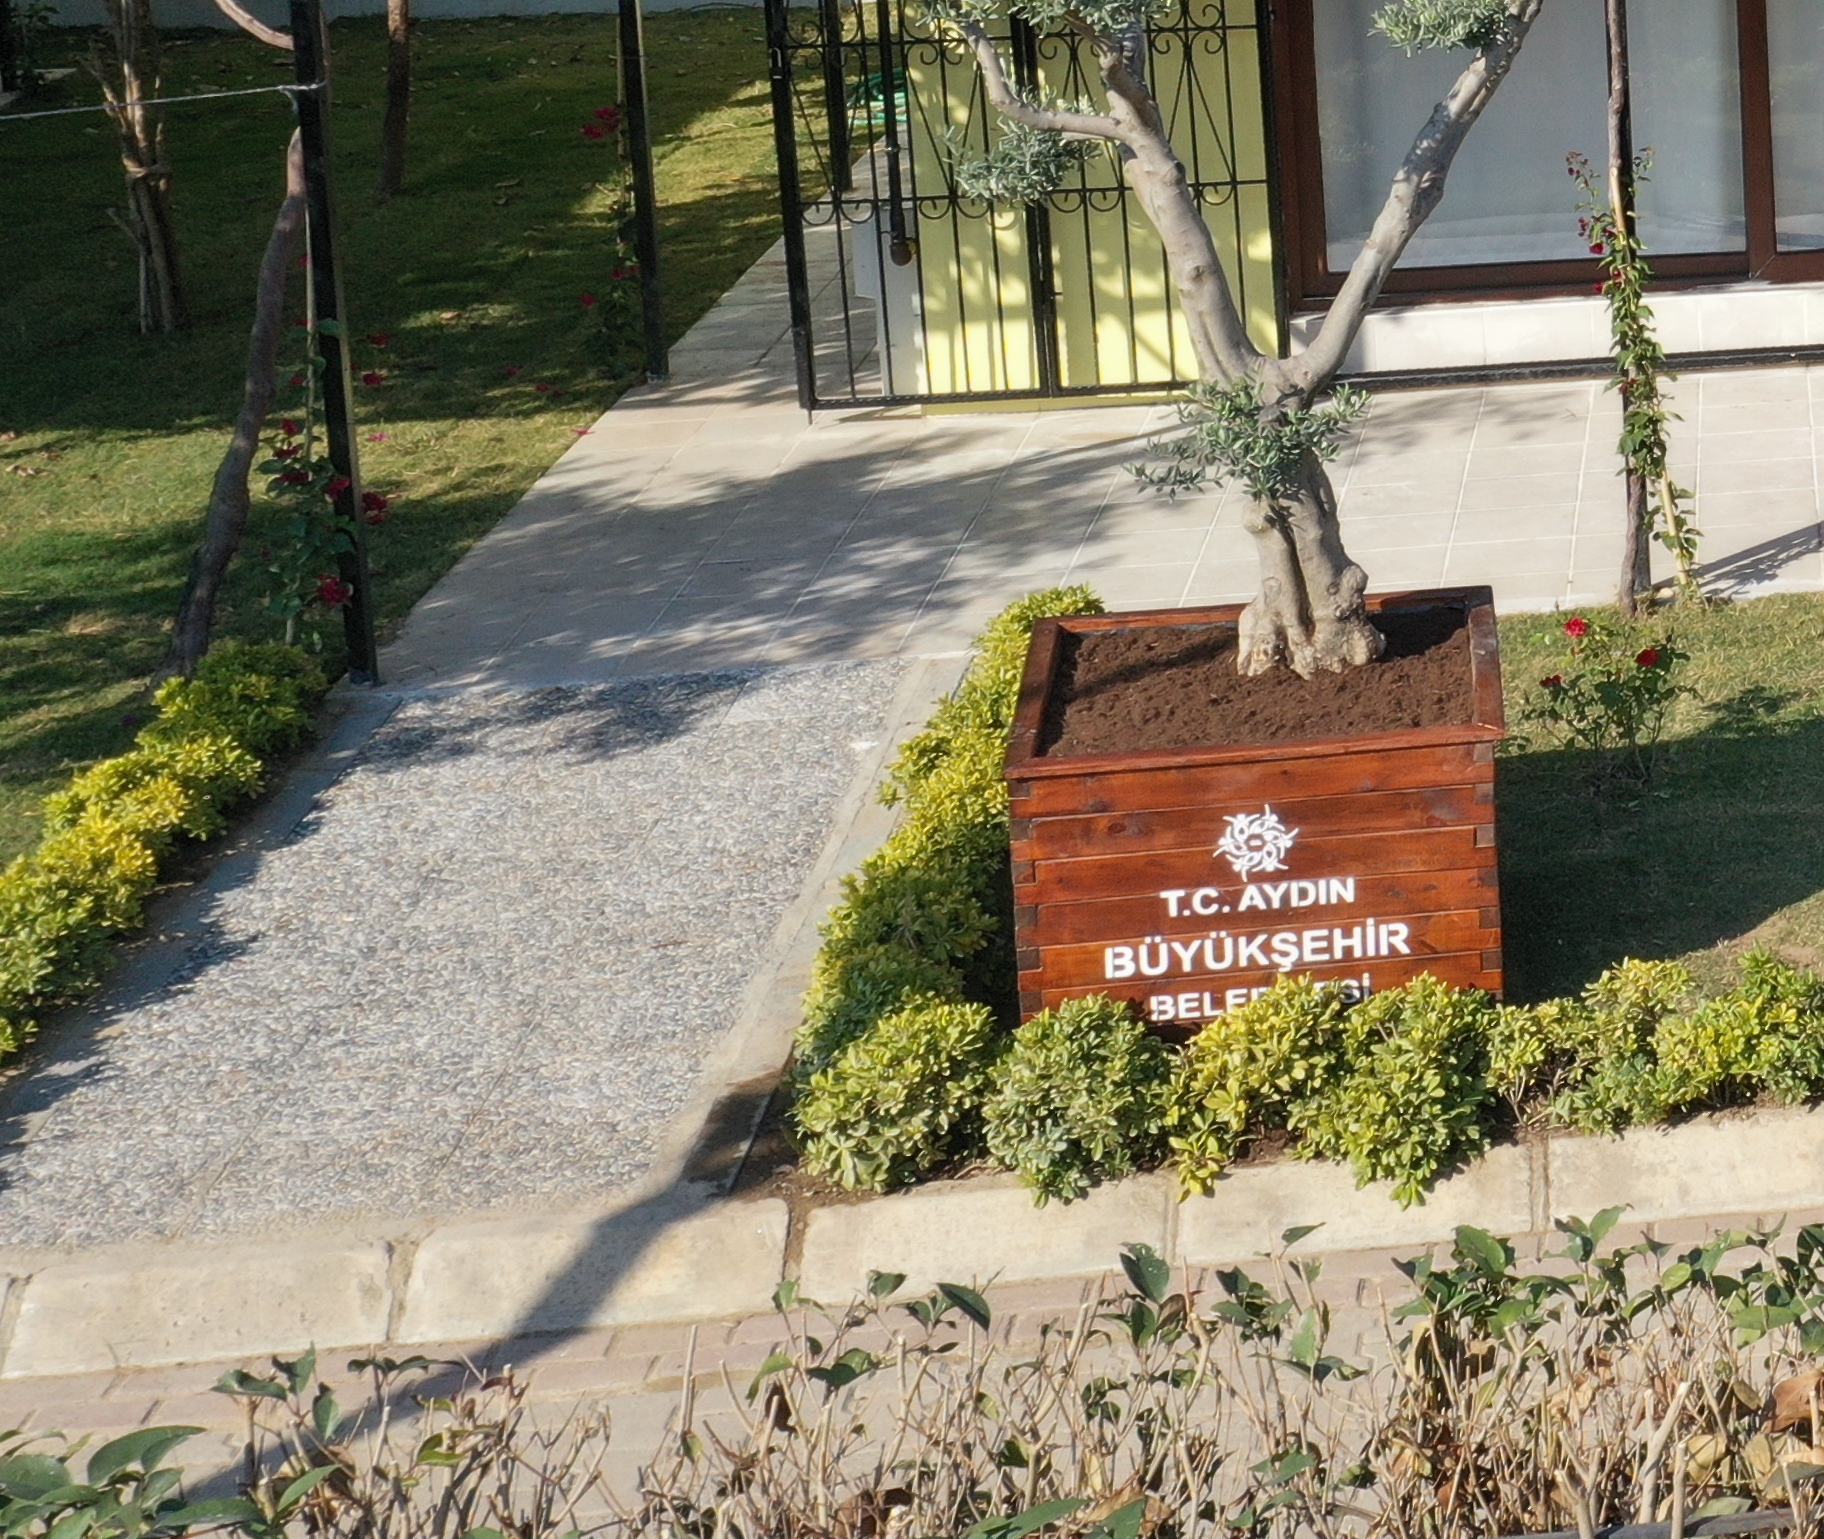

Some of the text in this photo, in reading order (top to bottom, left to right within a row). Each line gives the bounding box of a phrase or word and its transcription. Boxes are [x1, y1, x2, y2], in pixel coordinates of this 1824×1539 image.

[1160, 875, 1355, 918] T.C. AYDIN
[1104, 918, 1411, 980] BÜYÜKŞEHİR
